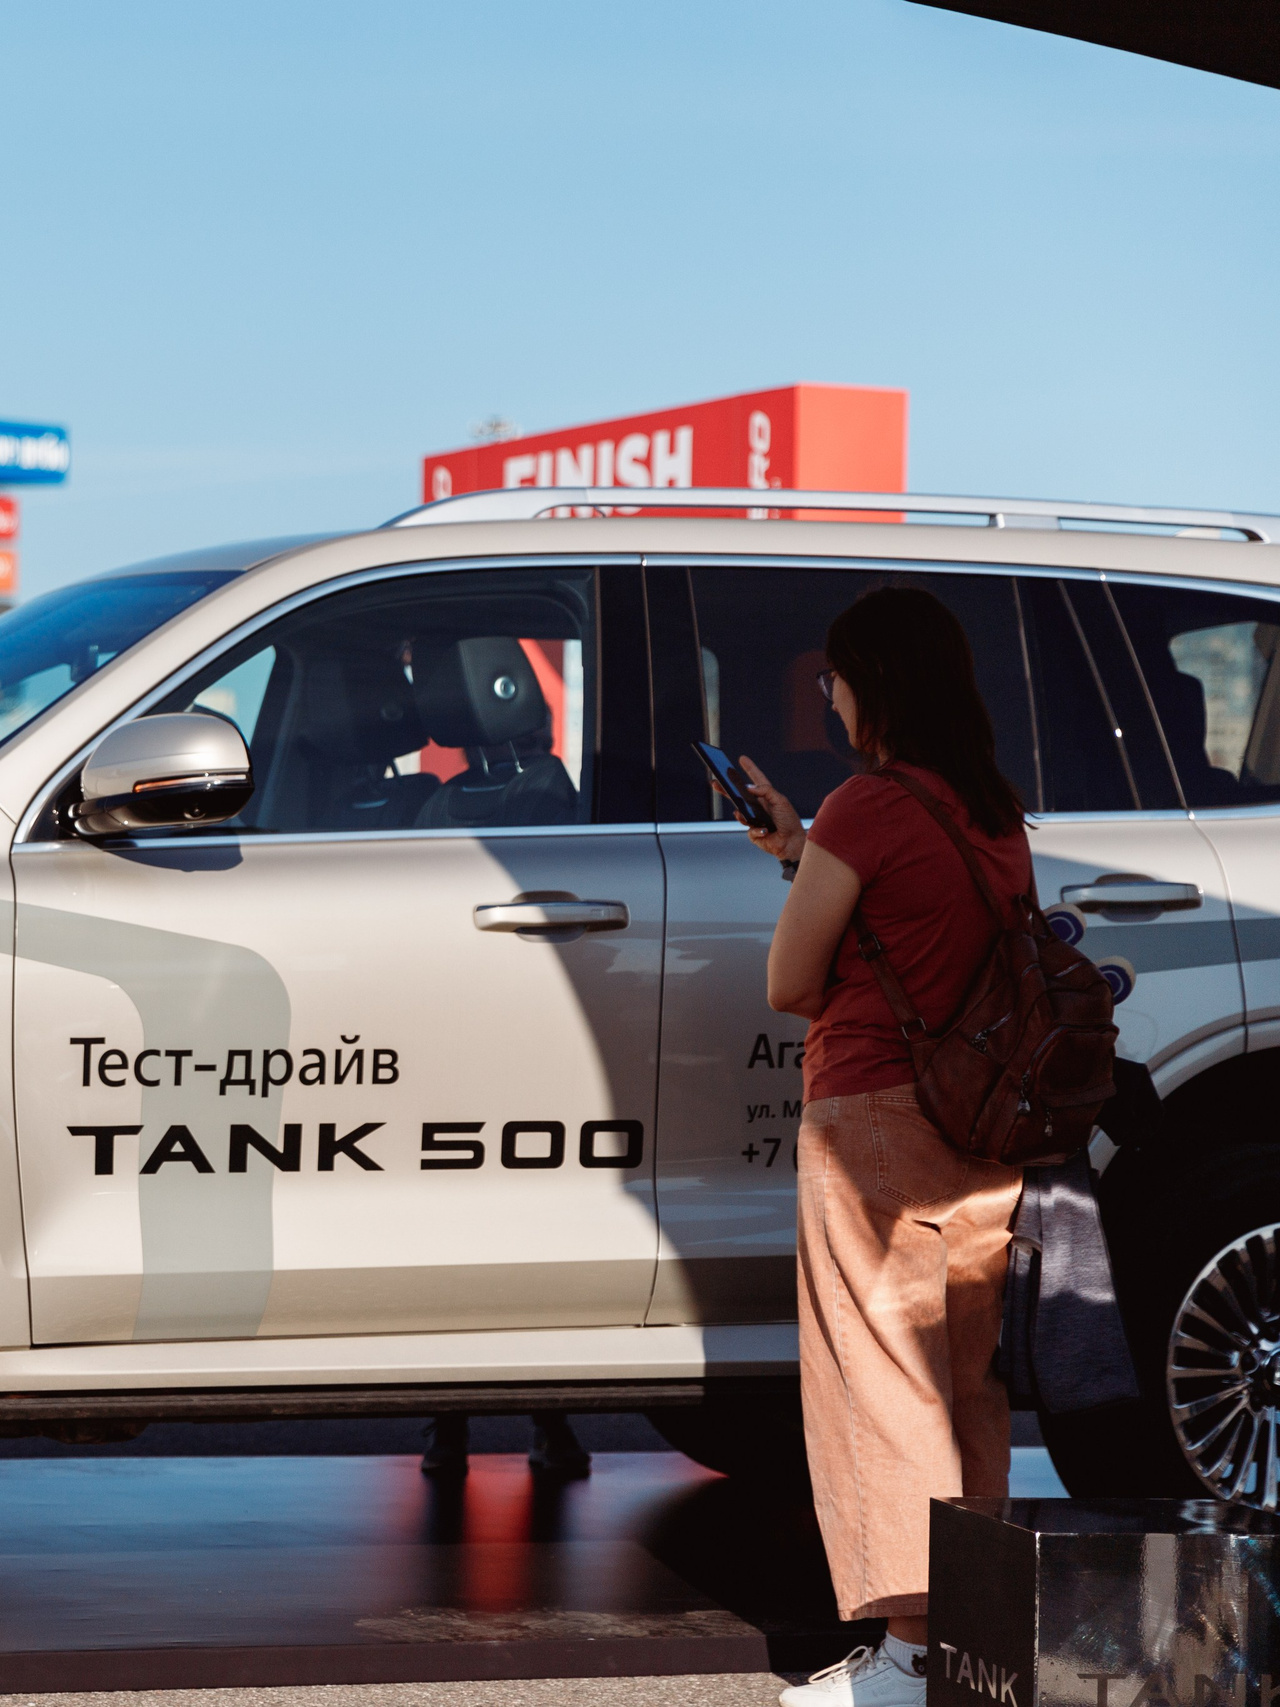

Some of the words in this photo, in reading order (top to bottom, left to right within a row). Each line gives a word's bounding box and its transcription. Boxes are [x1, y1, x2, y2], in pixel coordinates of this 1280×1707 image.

[503, 425, 694, 518] FINISH
[70, 1035, 400, 1098] Тест-драйв
[747, 1104, 776, 1123] ул.
[66, 1122, 387, 1176] TANK
[420, 1119, 644, 1170] 500
[741, 1138, 782, 1168] +7
[939, 1641, 1019, 1707] TANK
